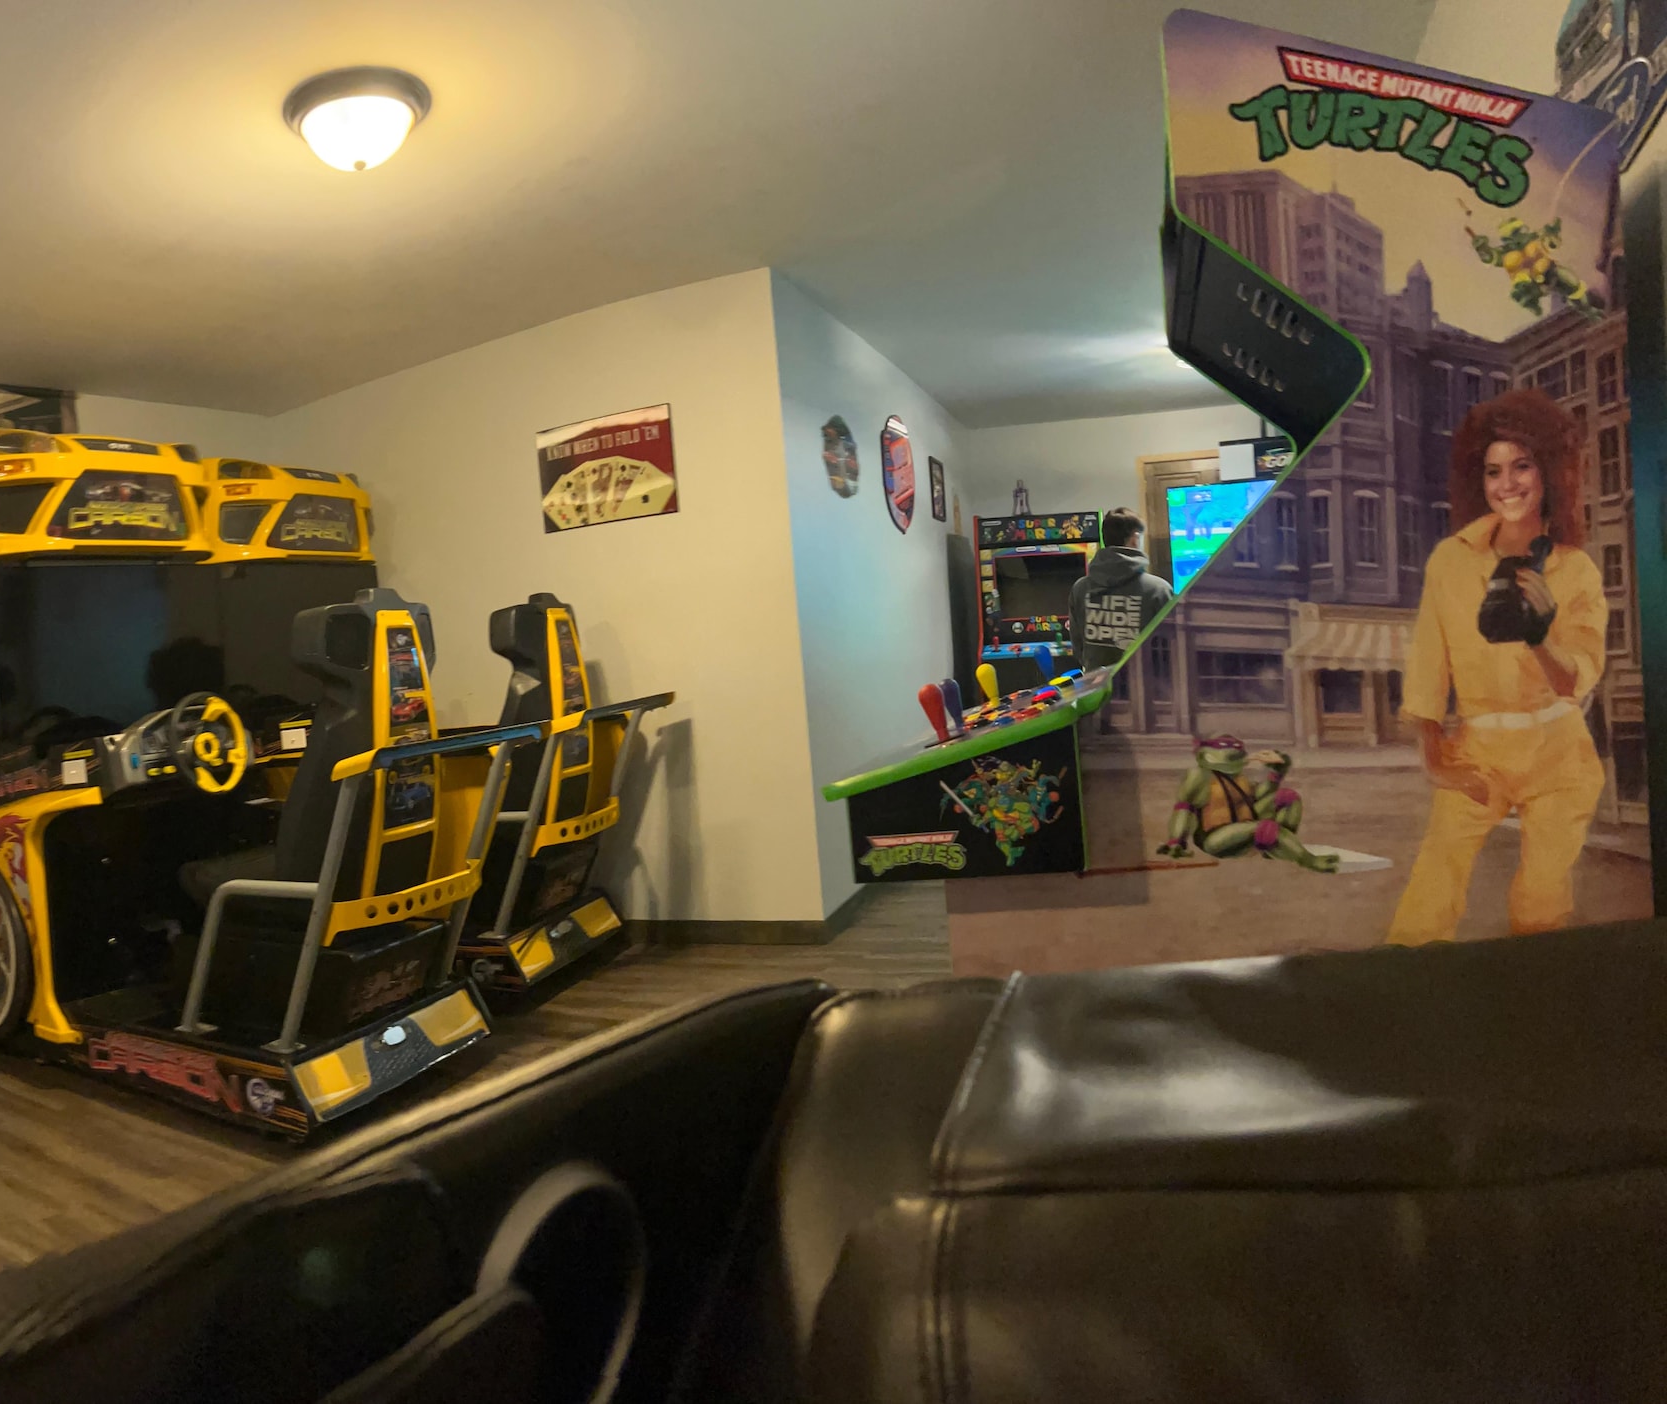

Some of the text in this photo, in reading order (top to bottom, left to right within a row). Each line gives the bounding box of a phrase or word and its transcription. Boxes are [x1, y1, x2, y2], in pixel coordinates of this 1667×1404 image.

[1285, 55, 1518, 121] TEENAGE MUTANT NINJA
[1229, 84, 1533, 208] TURTLES
[547, 442, 571, 461] KNOW
[573, 437, 600, 456] WHEN
[600, 433, 614, 449] TO
[614, 428, 641, 447] FOLD
[68, 507, 179, 532] CARBON
[1018, 517, 1056, 529] SUPER
[1014, 528, 1061, 540] MARIO
[1085, 593, 1142, 611] LIFE
[1026, 622, 1063, 632] MARIO
[1029, 614, 1058, 624] SUPER
[1085, 609, 1141, 627] WIDE
[1085, 624, 1140, 642] OPEN
[859, 842, 966, 876] TURTLES
[88, 1037, 243, 1114] CARBON
